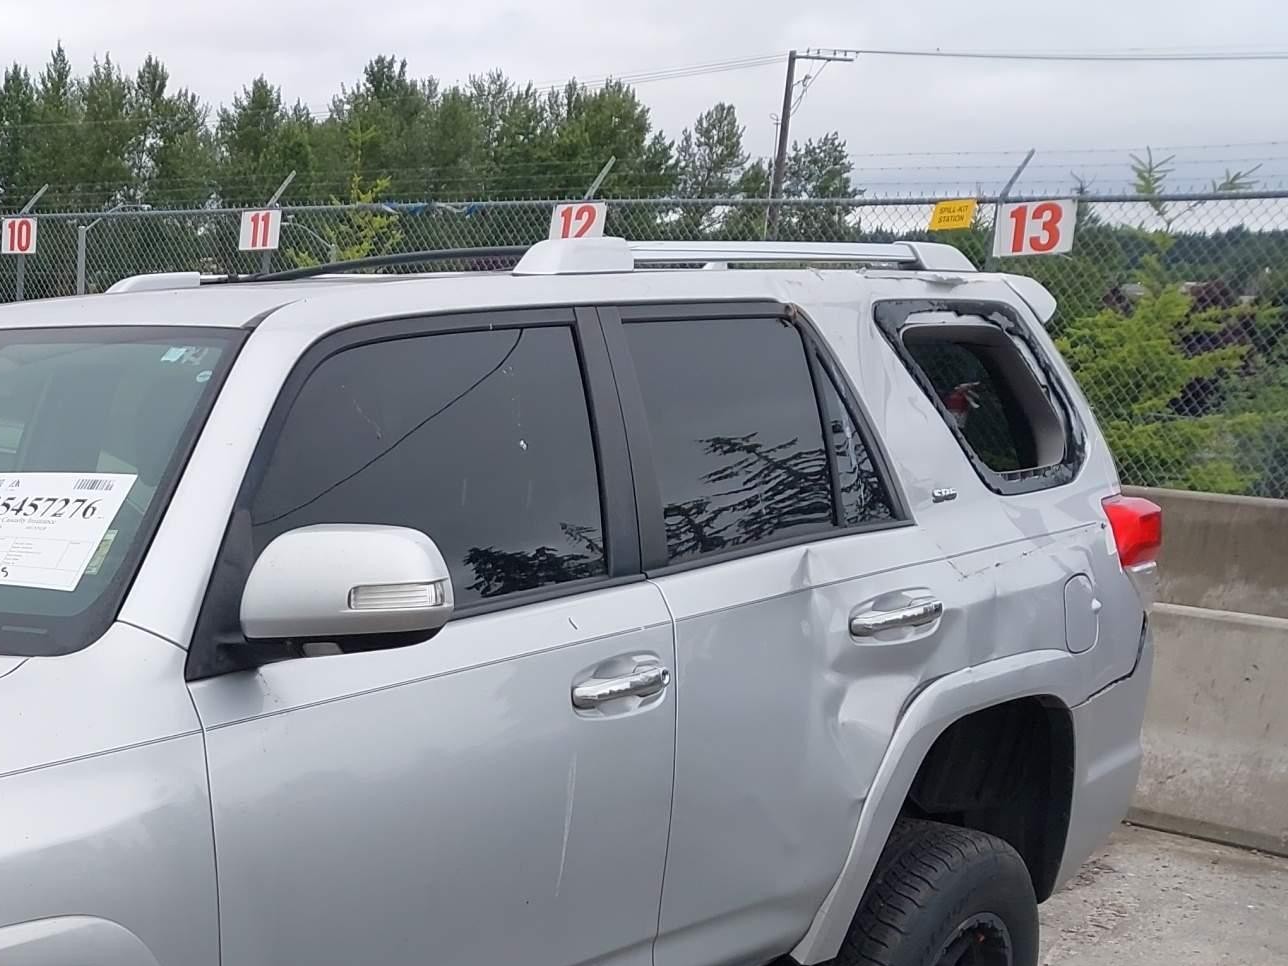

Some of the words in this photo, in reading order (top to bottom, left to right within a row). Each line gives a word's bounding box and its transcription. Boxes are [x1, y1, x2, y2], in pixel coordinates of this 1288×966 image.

[8, 219, 32, 252] 10
[251, 212, 271, 248] 11
[560, 204, 597, 238] 12
[938, 214, 965, 224] STATION
[1010, 203, 1063, 253] 13
